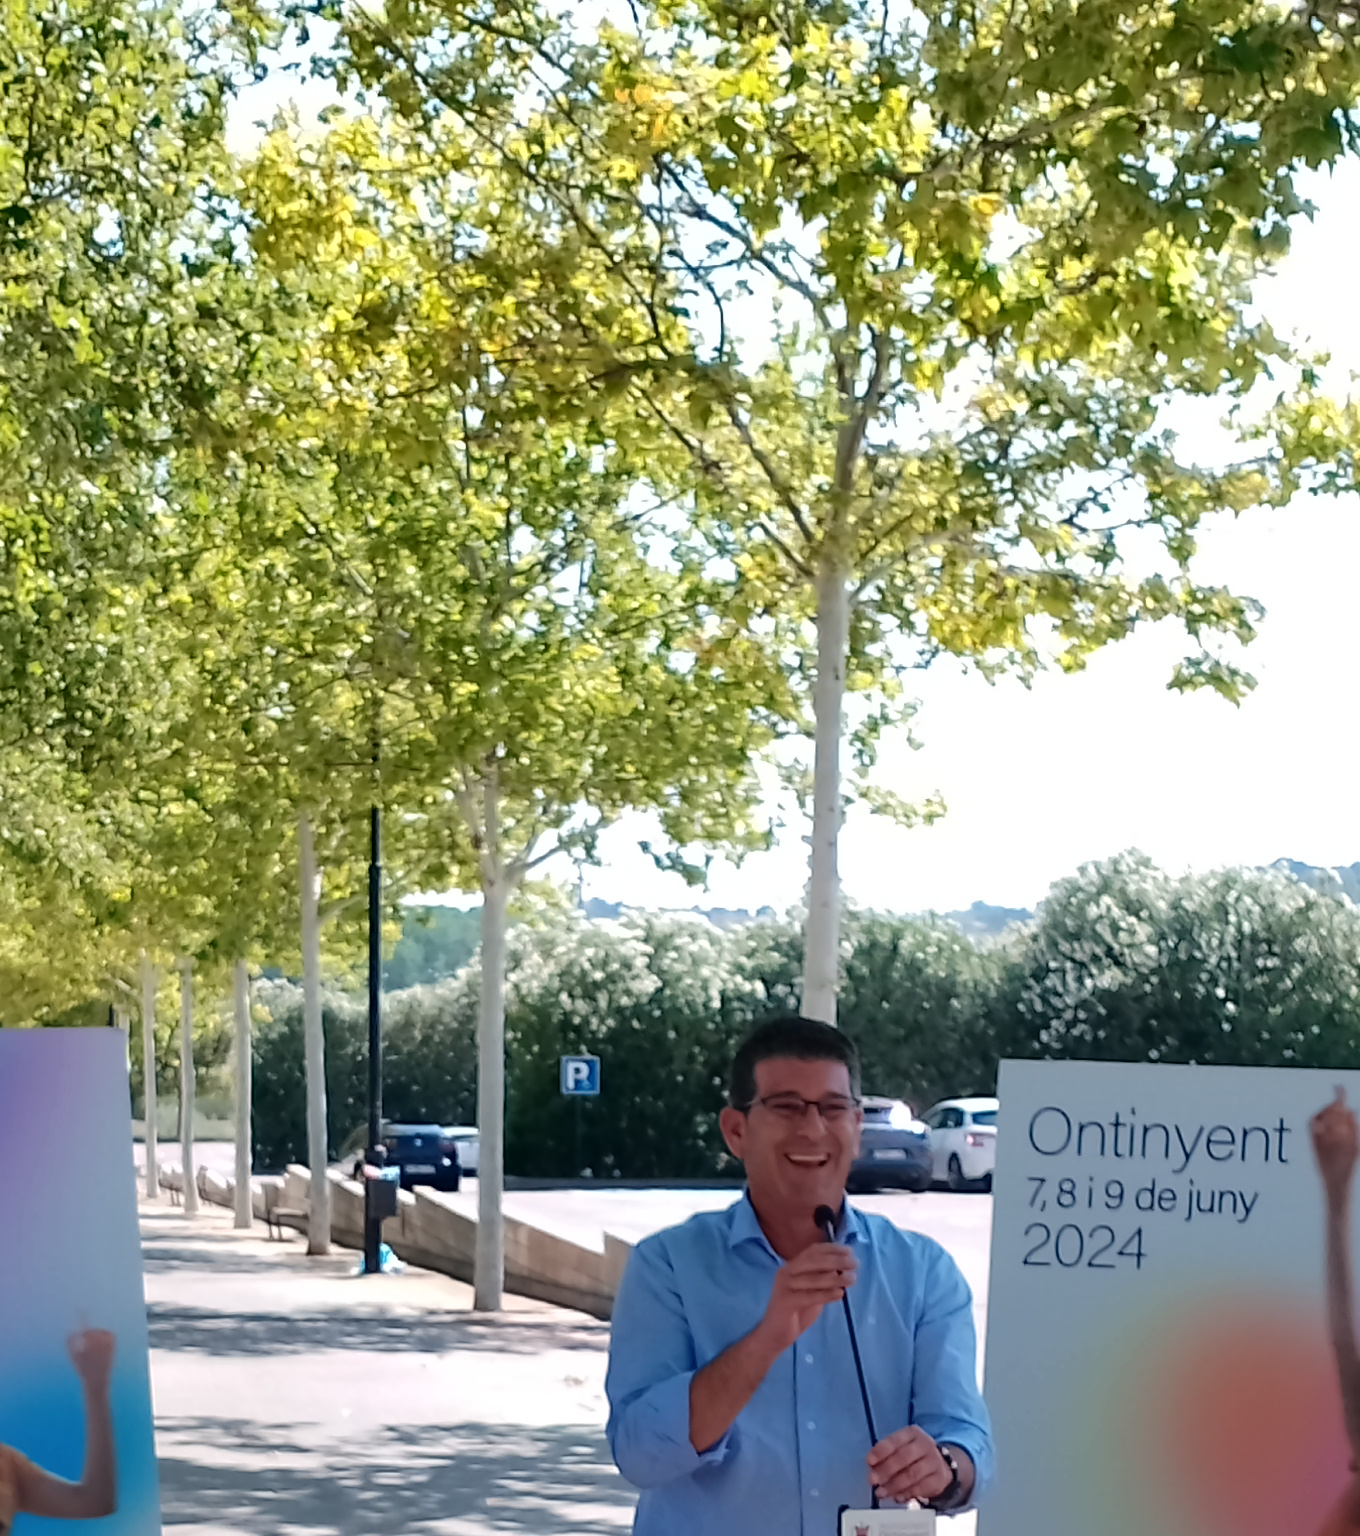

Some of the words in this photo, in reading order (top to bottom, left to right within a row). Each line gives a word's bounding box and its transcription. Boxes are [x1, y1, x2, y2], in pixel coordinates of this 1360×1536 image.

[566, 1061, 589, 1089] P
[1029, 1106, 1292, 1174] Ontinyent
[1135, 1178, 1177, 1212] de
[1184, 1178, 1259, 1224] juny
[1022, 1222, 1147, 1270] 2024
